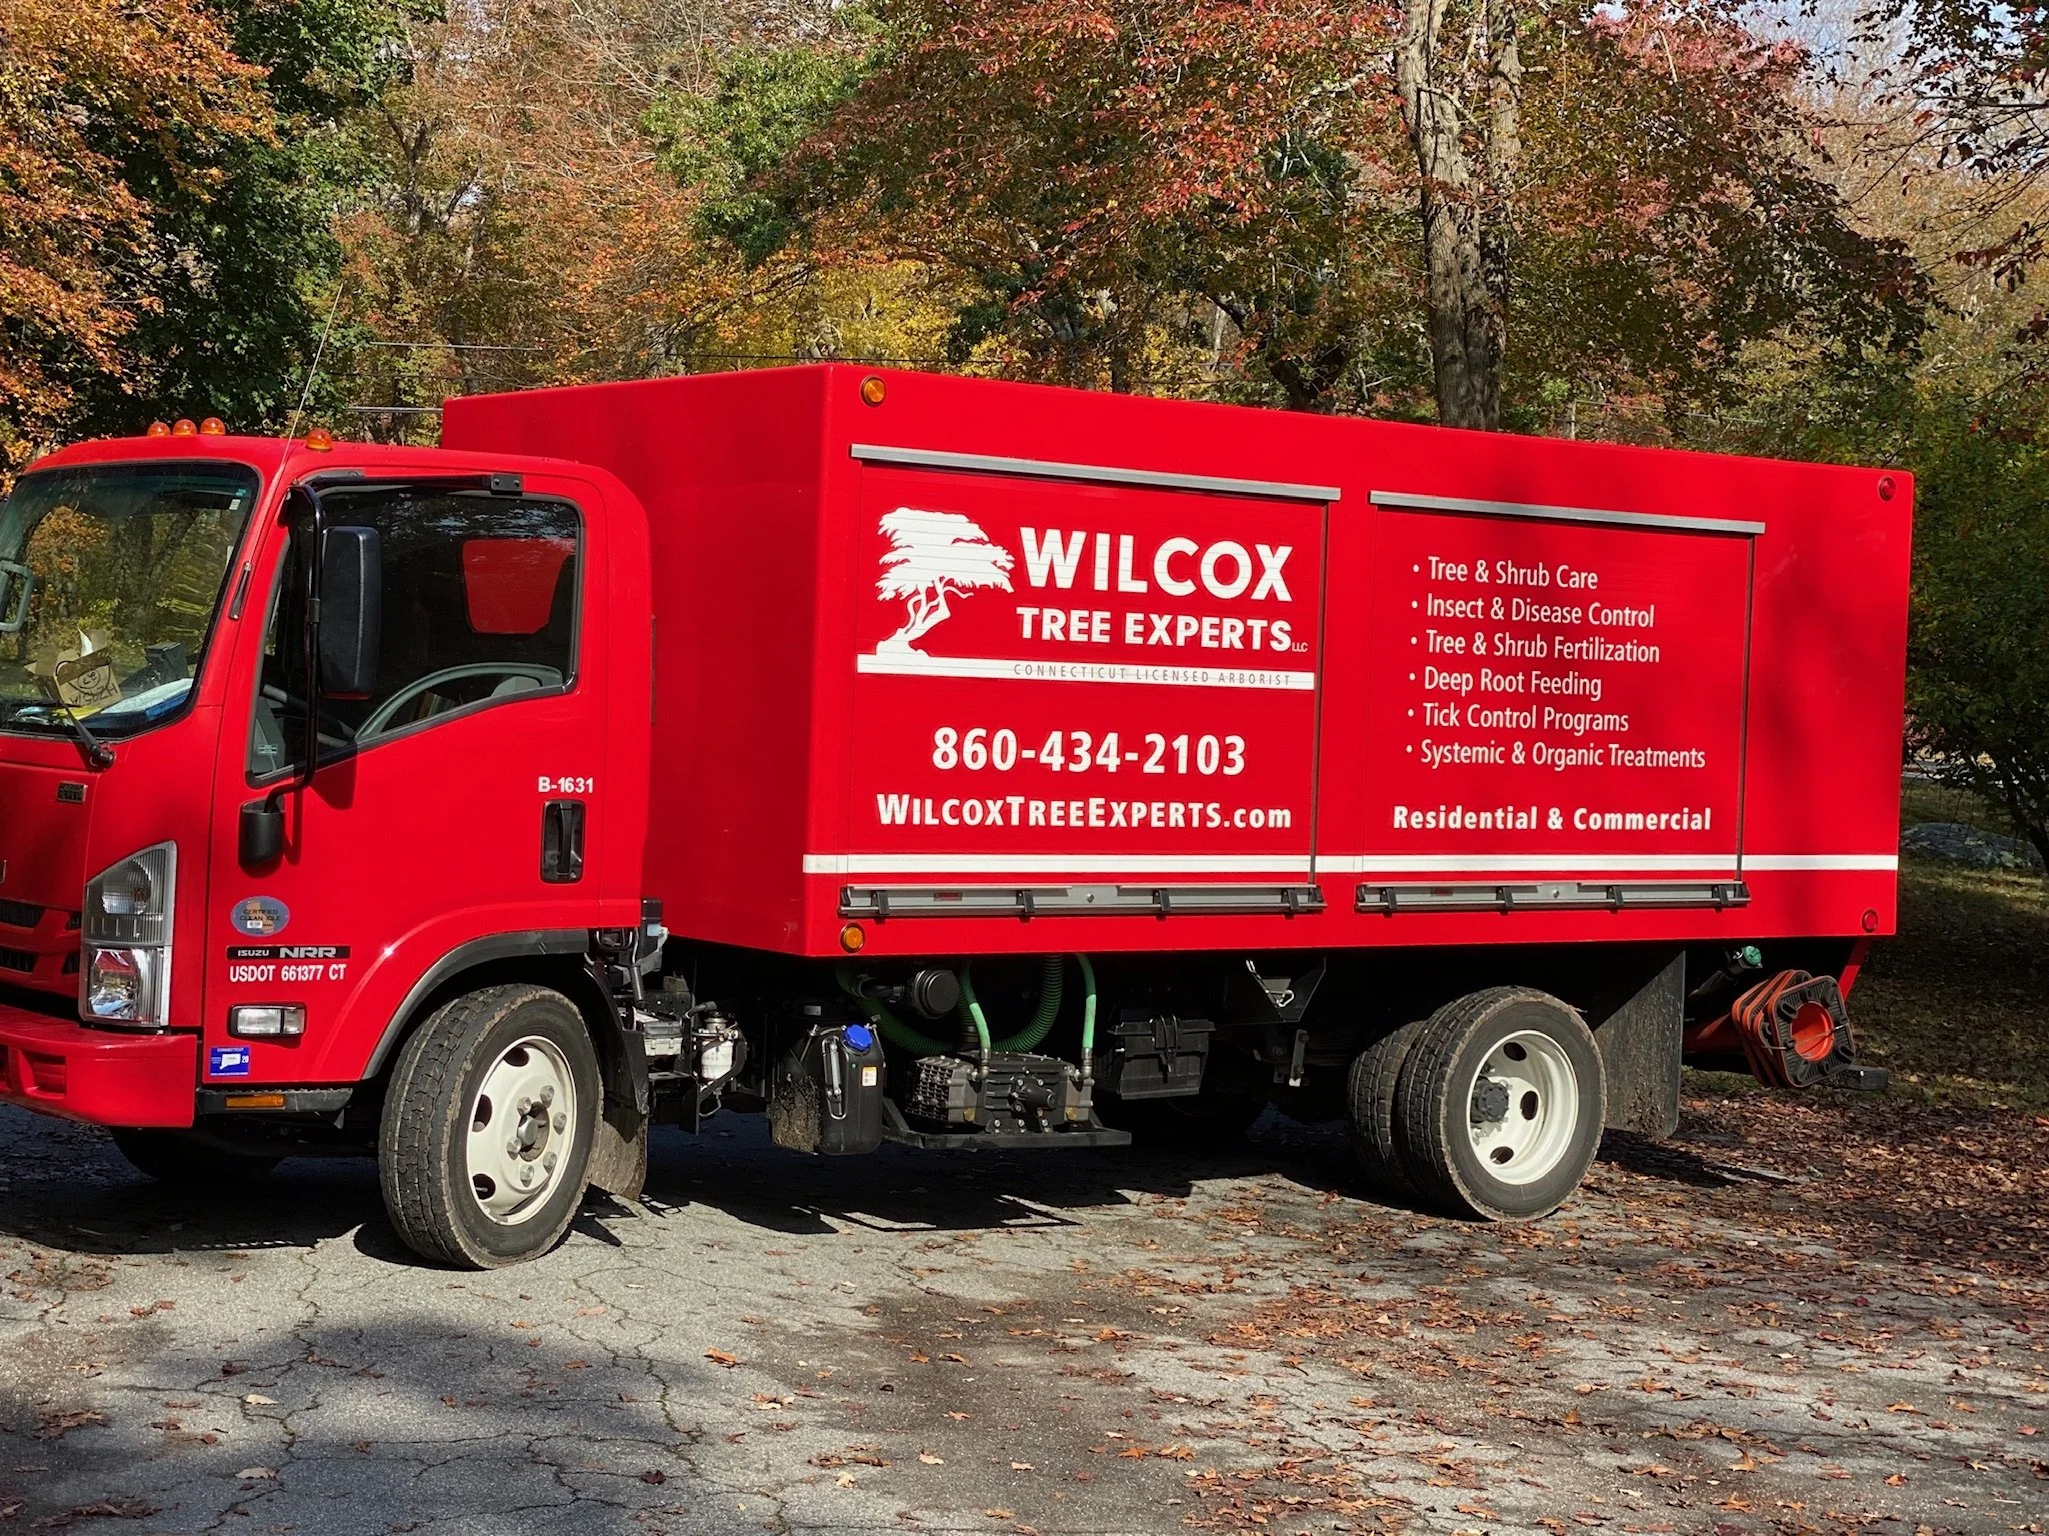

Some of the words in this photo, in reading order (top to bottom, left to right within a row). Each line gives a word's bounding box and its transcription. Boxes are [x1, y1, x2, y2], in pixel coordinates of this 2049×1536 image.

[1019, 526, 1293, 602] WILCOX
[1427, 555, 1468, 582] Tree
[1474, 559, 1489, 583] &
[1495, 559, 1550, 587] Shrub
[1556, 564, 1599, 590] Care
[1427, 592, 1485, 619] Insect
[1490, 596, 1505, 620] &
[1511, 597, 1582, 625] Disease
[1588, 601, 1655, 628] Control
[1016, 606, 1112, 643] TREE
[1124, 612, 1292, 652] EXPERTS
[1291, 642, 1308, 653] LLC
[1425, 629, 1466, 655] Tree
[1472, 631, 1487, 656] &
[1493, 631, 1548, 658] Shrub
[1554, 635, 1660, 663] Fertilization
[1013, 663, 1126, 680] CONNECTICUT
[1136, 668, 1210, 684] LICENSED
[1218, 672, 1292, 687] ARBORIST
[1424, 665, 1474, 697] Deep
[1480, 668, 1525, 693] Root
[1531, 670, 1602, 702] Feeding
[1422, 701, 1461, 727] Tick
[1467, 703, 1537, 729] Control
[1543, 706, 1629, 737] Programs
[932, 726, 1245, 776] 860-434-2103
[1421, 738, 1506, 770] Systemic
[1511, 740, 1526, 765] &
[1532, 741, 1604, 772] Organic
[1608, 743, 1706, 768] Treatments
[538, 776, 594, 794] B-1631
[1393, 804, 1538, 830] Residential
[1546, 807, 1564, 830] &
[1573, 807, 1711, 831] Commercial
[237, 949, 270, 957] ISUZU
[279, 947, 337, 958] NRR
[229, 964, 276, 983] USDOT
[281, 964, 325, 982] 661377
[328, 963, 347, 981] CT
